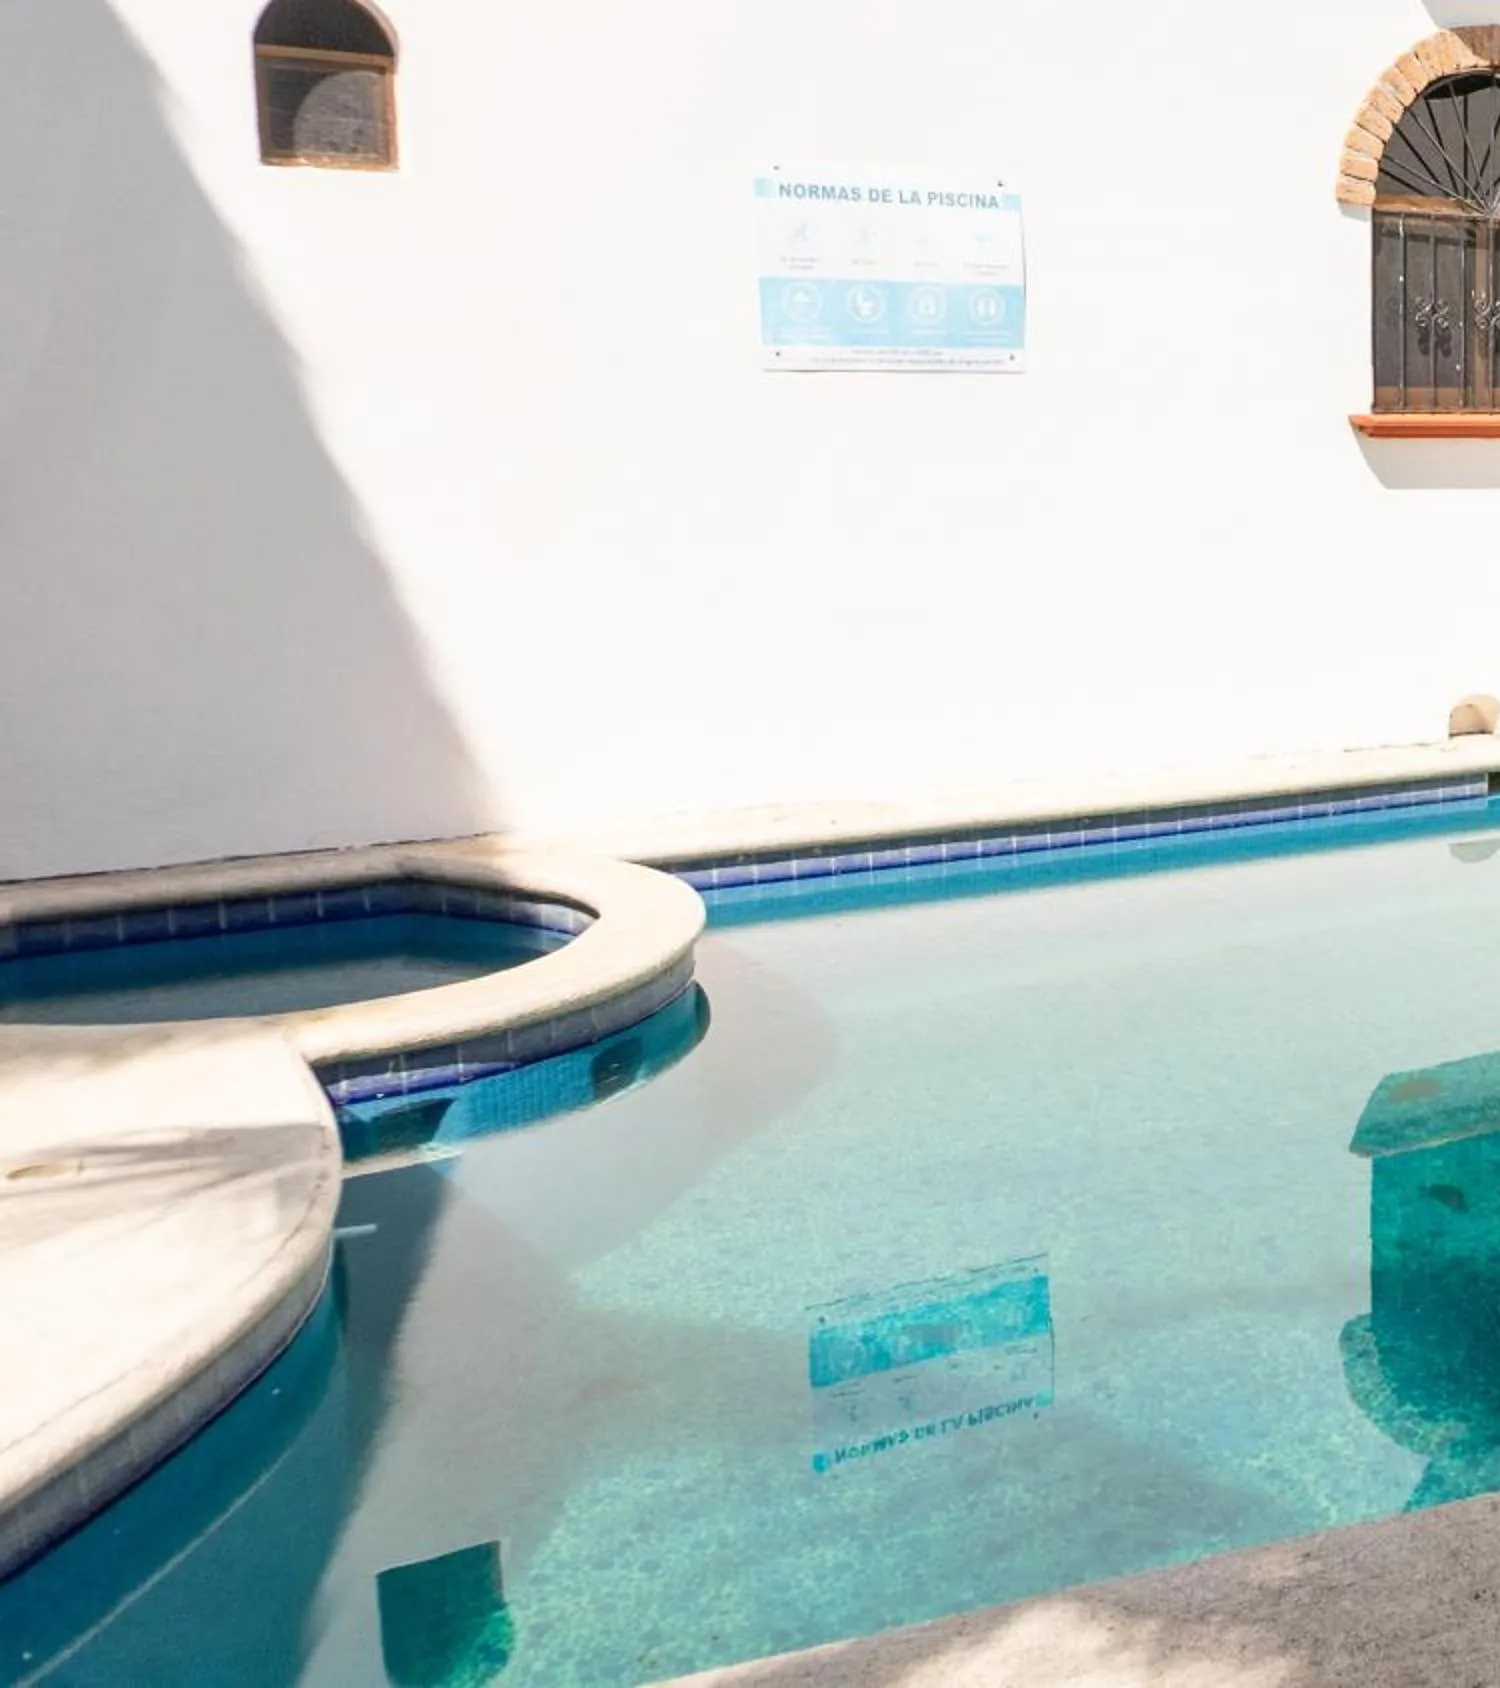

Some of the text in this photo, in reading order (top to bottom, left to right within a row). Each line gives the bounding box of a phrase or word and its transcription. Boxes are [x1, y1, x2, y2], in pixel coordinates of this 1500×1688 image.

[778, 183, 999, 209] NORMAS DE LA PISCINA
